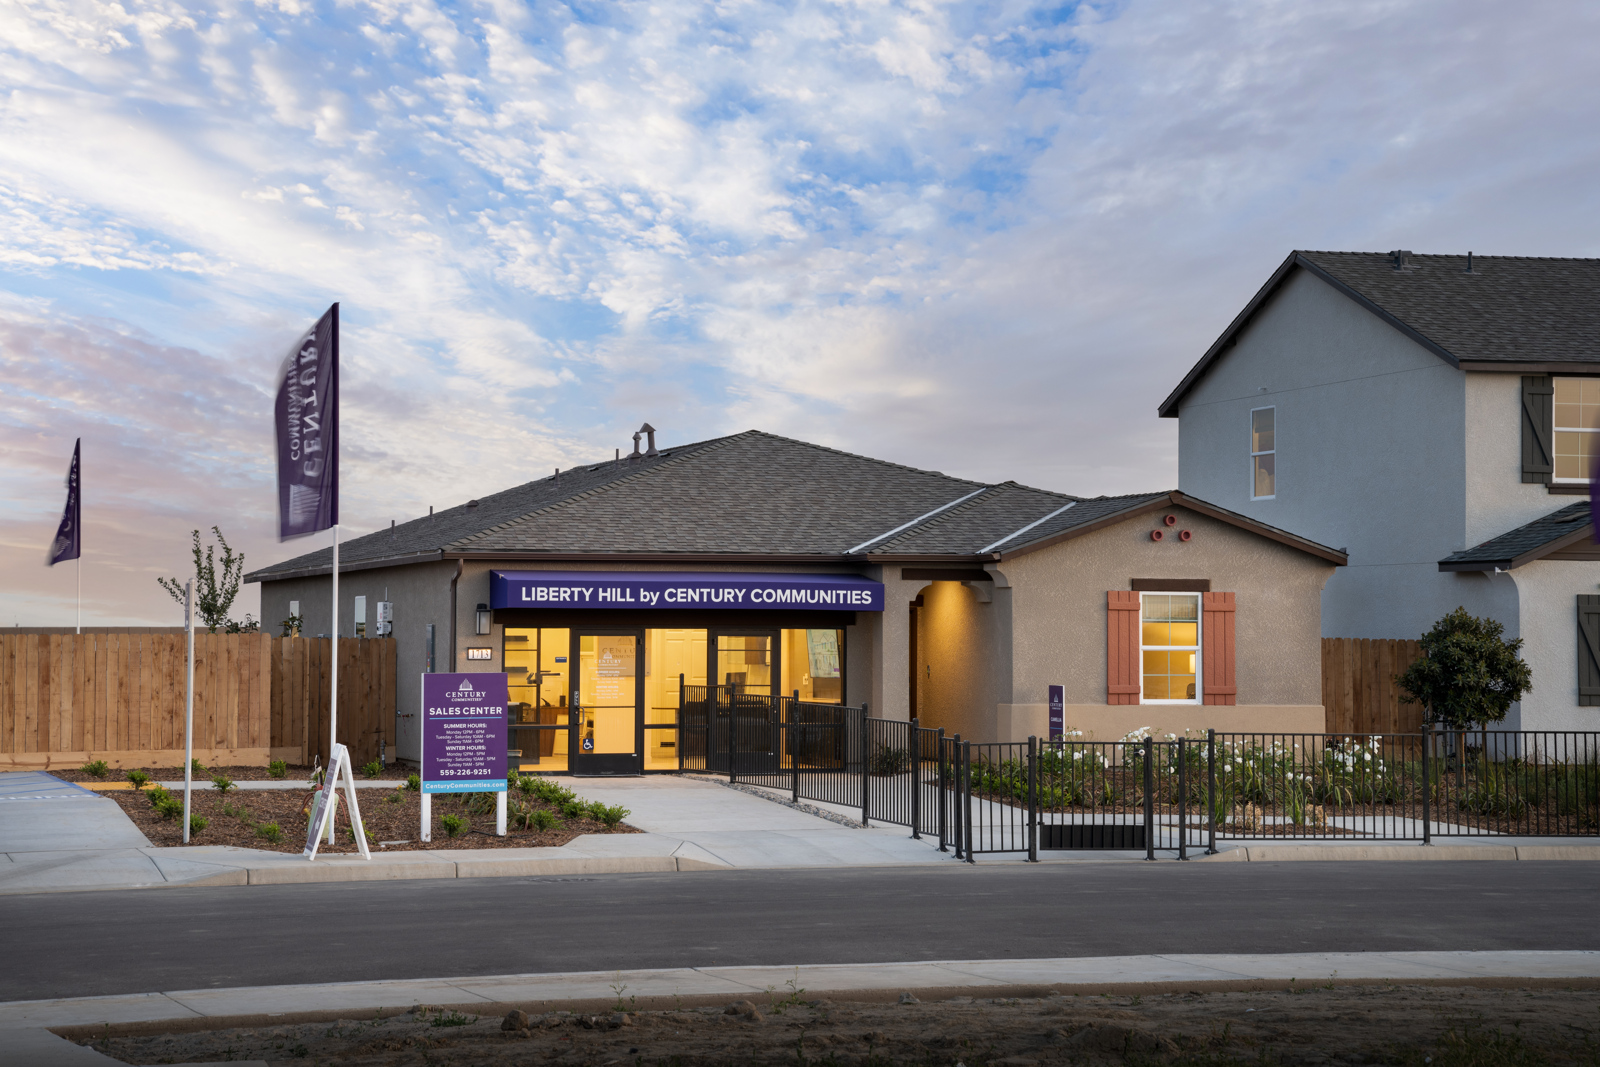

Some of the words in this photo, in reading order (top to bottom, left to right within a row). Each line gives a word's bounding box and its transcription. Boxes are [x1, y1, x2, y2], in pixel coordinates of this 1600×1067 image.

[521, 587, 594, 601] LIBERTY
[598, 588, 635, 602] HILL
[640, 588, 660, 605] by
[664, 588, 746, 603] CENTURY
[750, 589, 872, 604] COMMUNITIES
[429, 707, 461, 715] SALES
[462, 706, 502, 715] CENTER
[425, 782, 505, 790] CenturyCommunities.com
